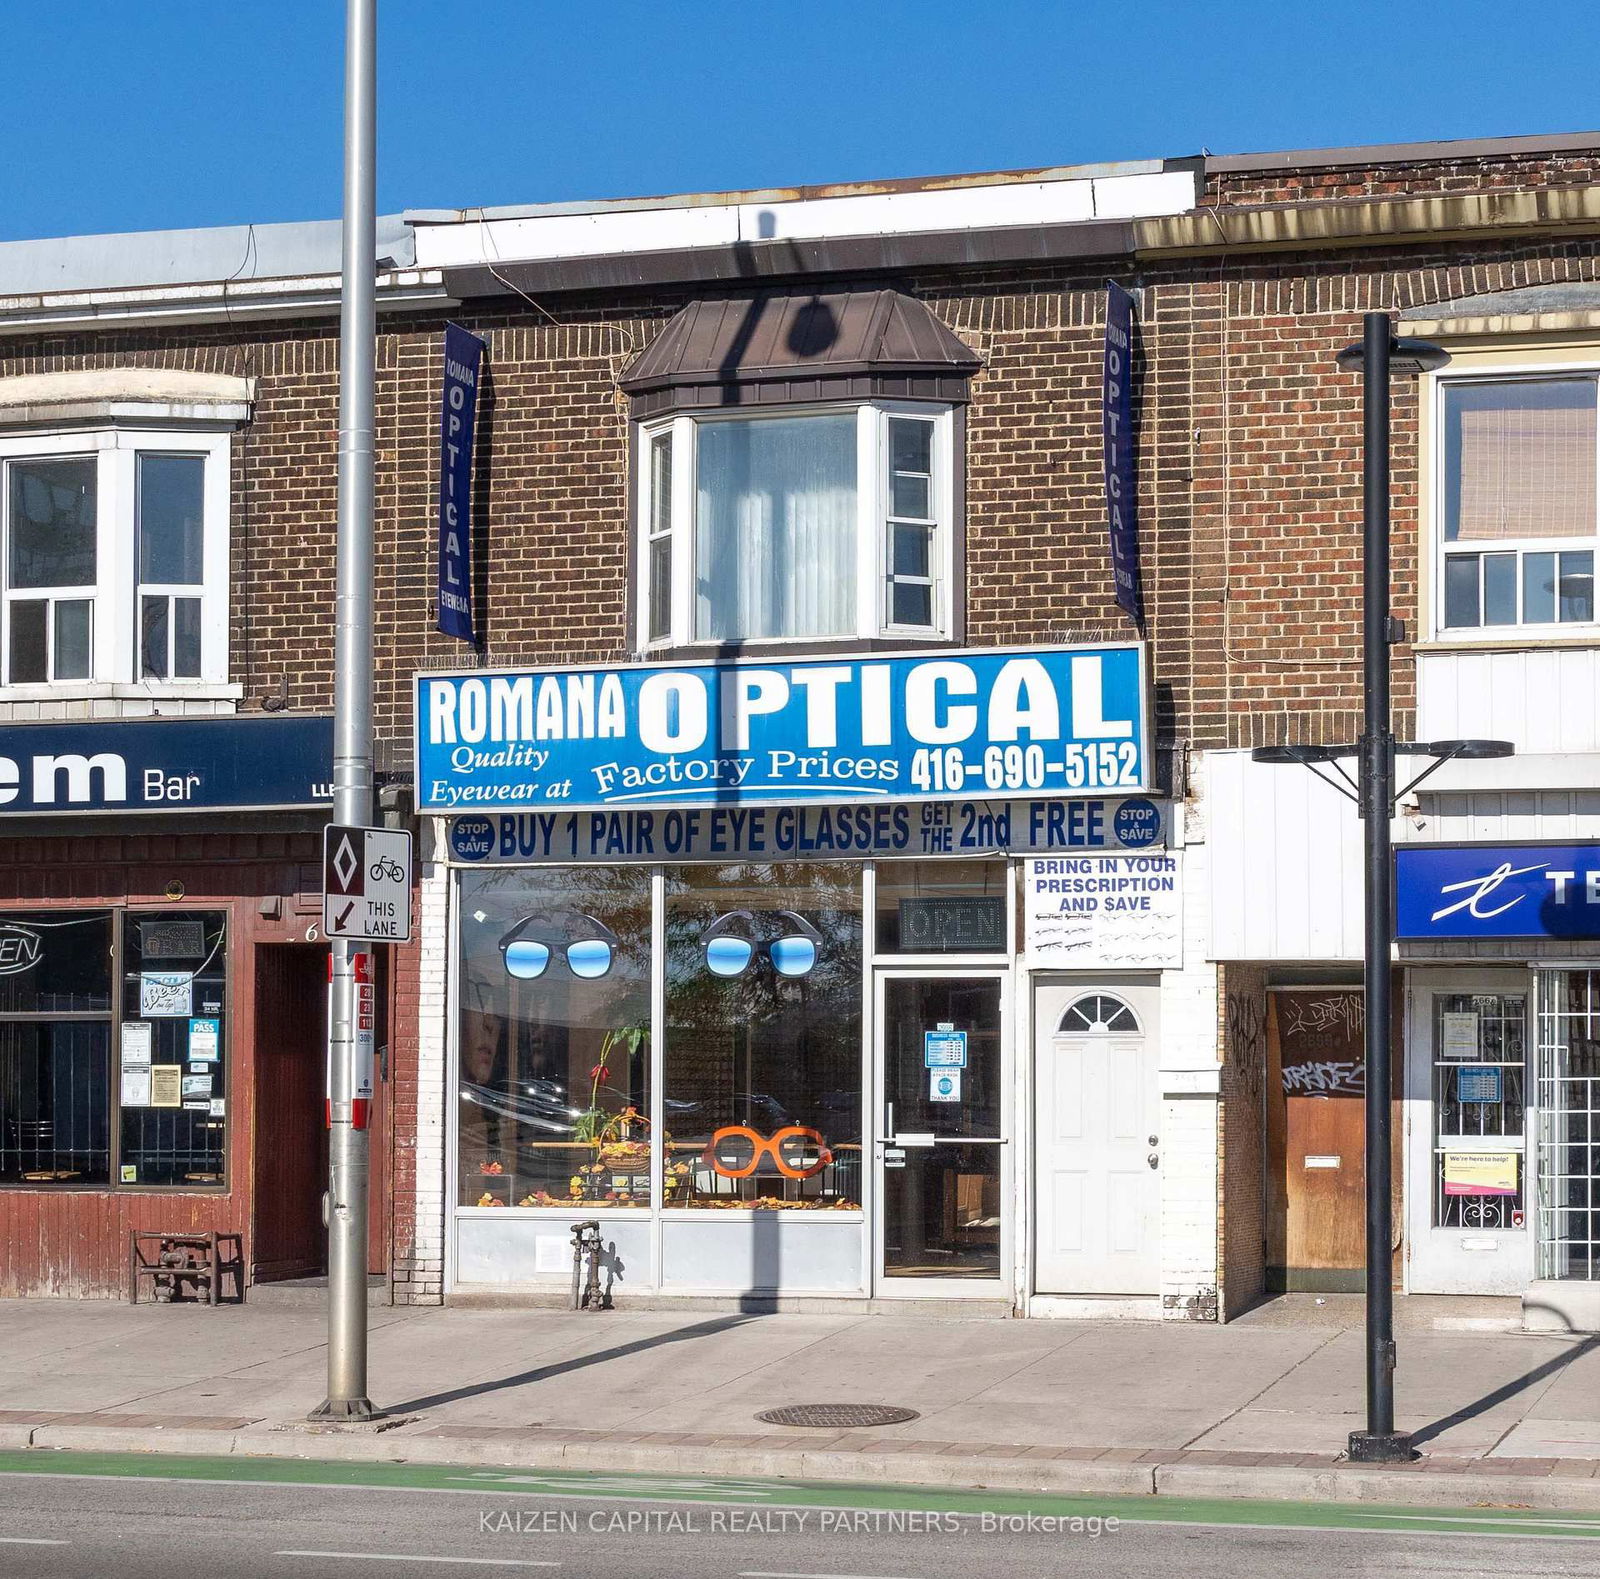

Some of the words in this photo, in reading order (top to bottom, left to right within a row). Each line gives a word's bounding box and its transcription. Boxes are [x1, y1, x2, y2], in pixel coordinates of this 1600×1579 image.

[1107, 349, 1125, 560] OPTICAL
[445, 386, 466, 586] OPTICAL
[429, 673, 626, 744] ROMANA
[638, 655, 1133, 754] OPTICAL
[451, 744, 549, 774] Quality
[910, 741, 1138, 792] 416-690-5152
[143, 768, 201, 801] Bar
[591, 755, 755, 794] Factory
[767, 750, 899, 780] Prices
[429, 780, 539, 806] Eyewear
[545, 779, 573, 798] at
[921, 800, 954, 826] GET
[959, 802, 1011, 848] 2nd
[1029, 800, 1104, 847] FREE
[1119, 809, 1154, 821] STOP
[457, 823, 489, 834] STOP
[500, 813, 558, 857] BUY
[567, 812, 578, 855] 1
[591, 811, 655, 855] PAIR
[663, 809, 700, 853] OF
[710, 807, 766, 851] EYE
[775, 804, 910, 850] GLASSES
[920, 827, 953, 852] THE
[1119, 828, 1153, 840] SAVE
[457, 842, 489, 853] SAVE
[1034, 859, 1092, 874] BRING
[1098, 858, 1118, 873] IN
[1123, 857, 1176, 873] YOUR
[1036, 877, 1174, 893] PRESCRIPTION
[367, 901, 395, 917] THIS
[1059, 897, 1098, 912] AND
[1104, 895, 1151, 912] $AVE
[364, 919, 397, 936] LANE
[909, 907, 995, 938] OPEN
[0, 938, 40, 961] EN
[144, 986, 191, 1011] Beer
[193, 1023, 214, 1033] PASS
